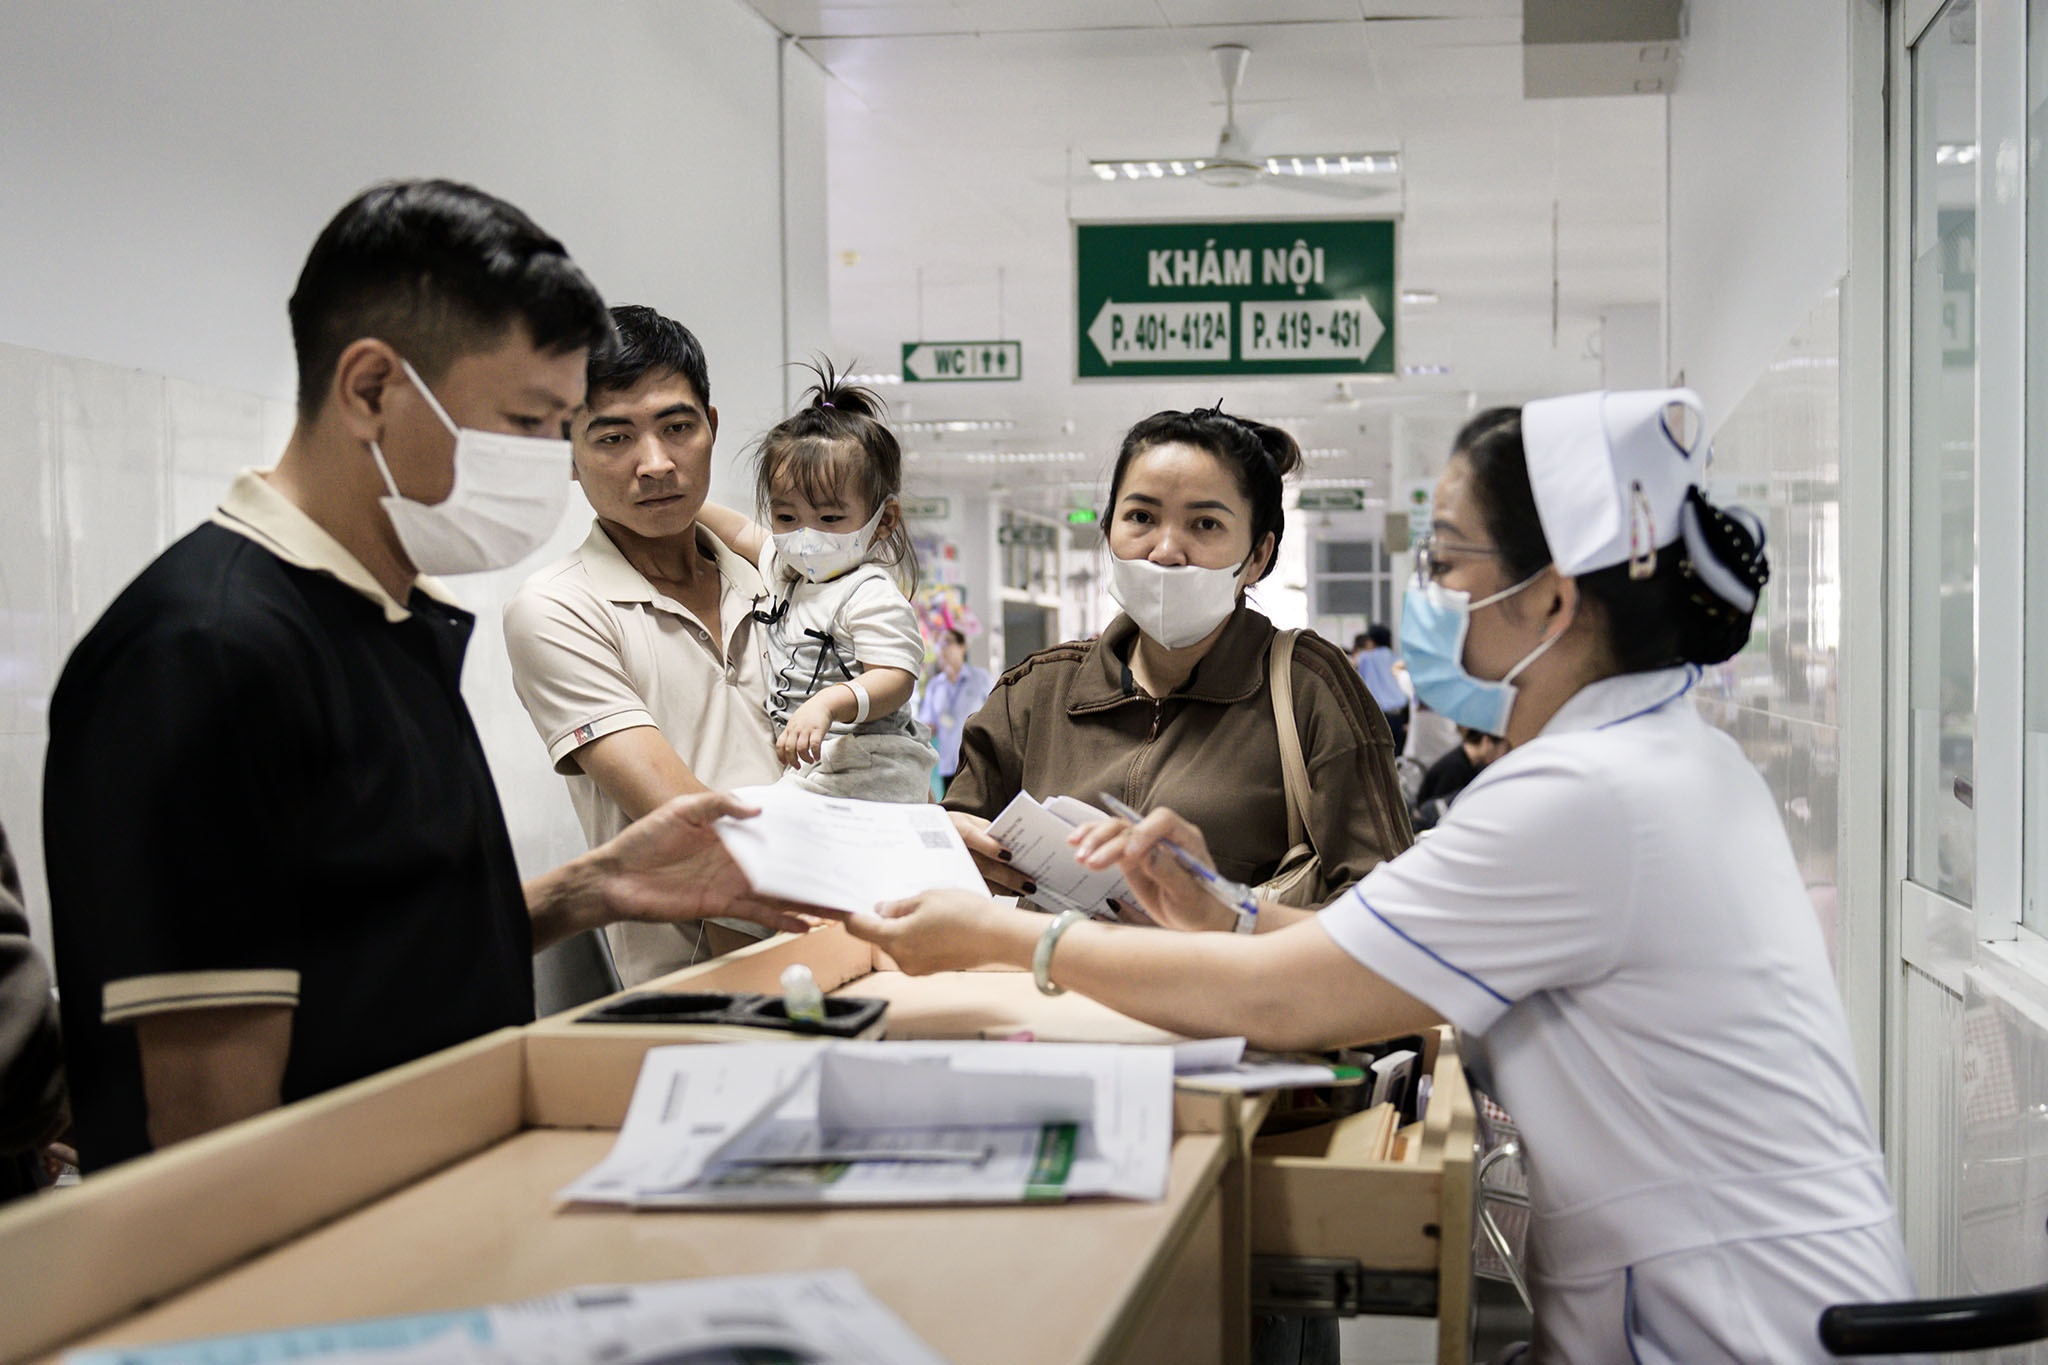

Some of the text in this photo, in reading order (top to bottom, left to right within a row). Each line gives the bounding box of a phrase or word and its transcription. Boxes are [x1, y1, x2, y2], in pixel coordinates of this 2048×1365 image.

[1148, 239, 1325, 295] KHÁM NỘI
[934, 349, 965, 375] WC
